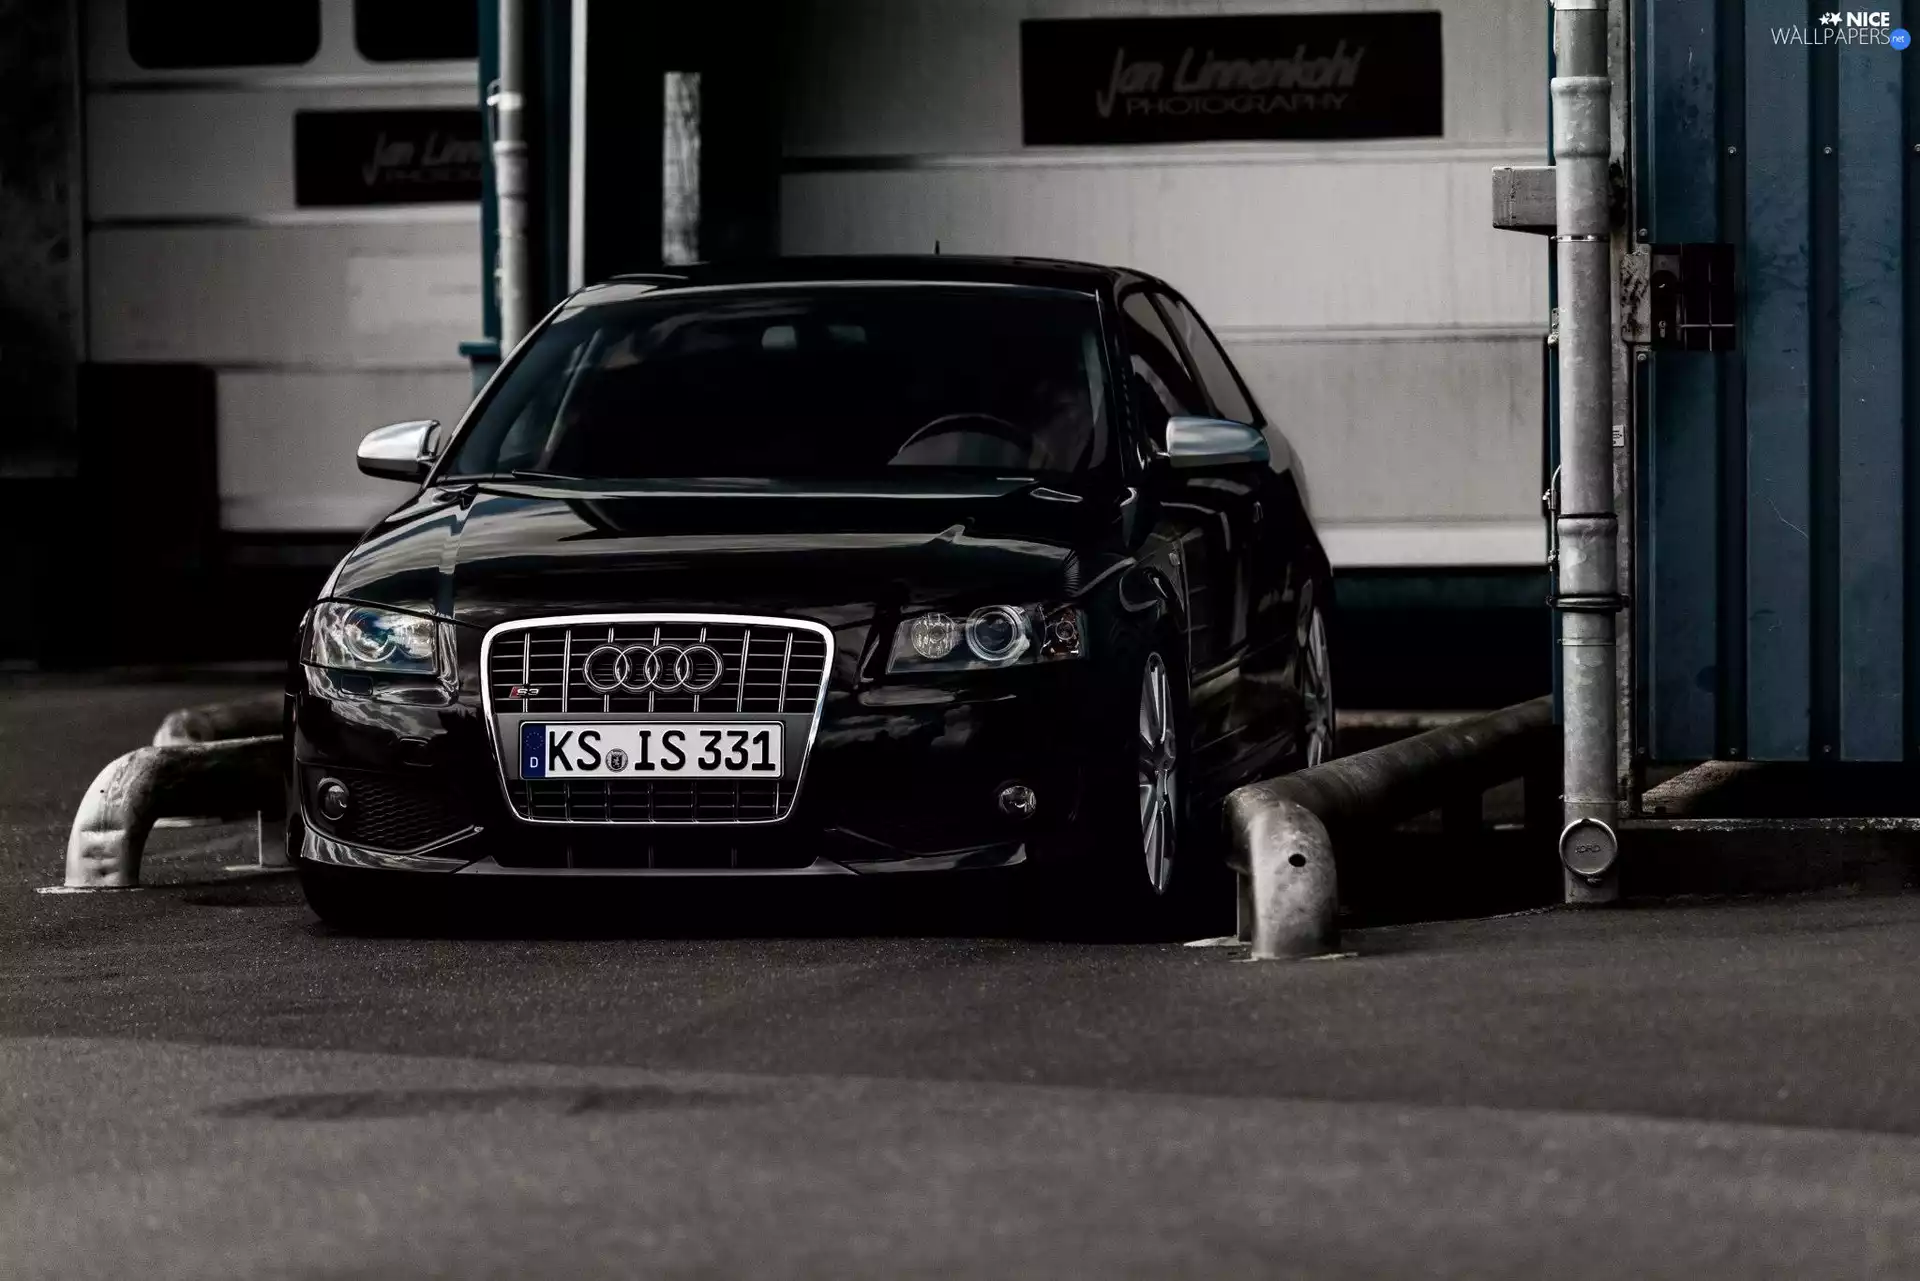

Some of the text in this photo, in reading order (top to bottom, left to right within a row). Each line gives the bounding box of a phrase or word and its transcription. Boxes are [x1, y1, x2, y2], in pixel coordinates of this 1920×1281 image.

[1095, 45, 1165, 119] Jan
[1125, 92, 1349, 116] PHOTOGRAPHY
[529, 756, 539, 768] D
[549, 730, 776, 771] KS IS 331
